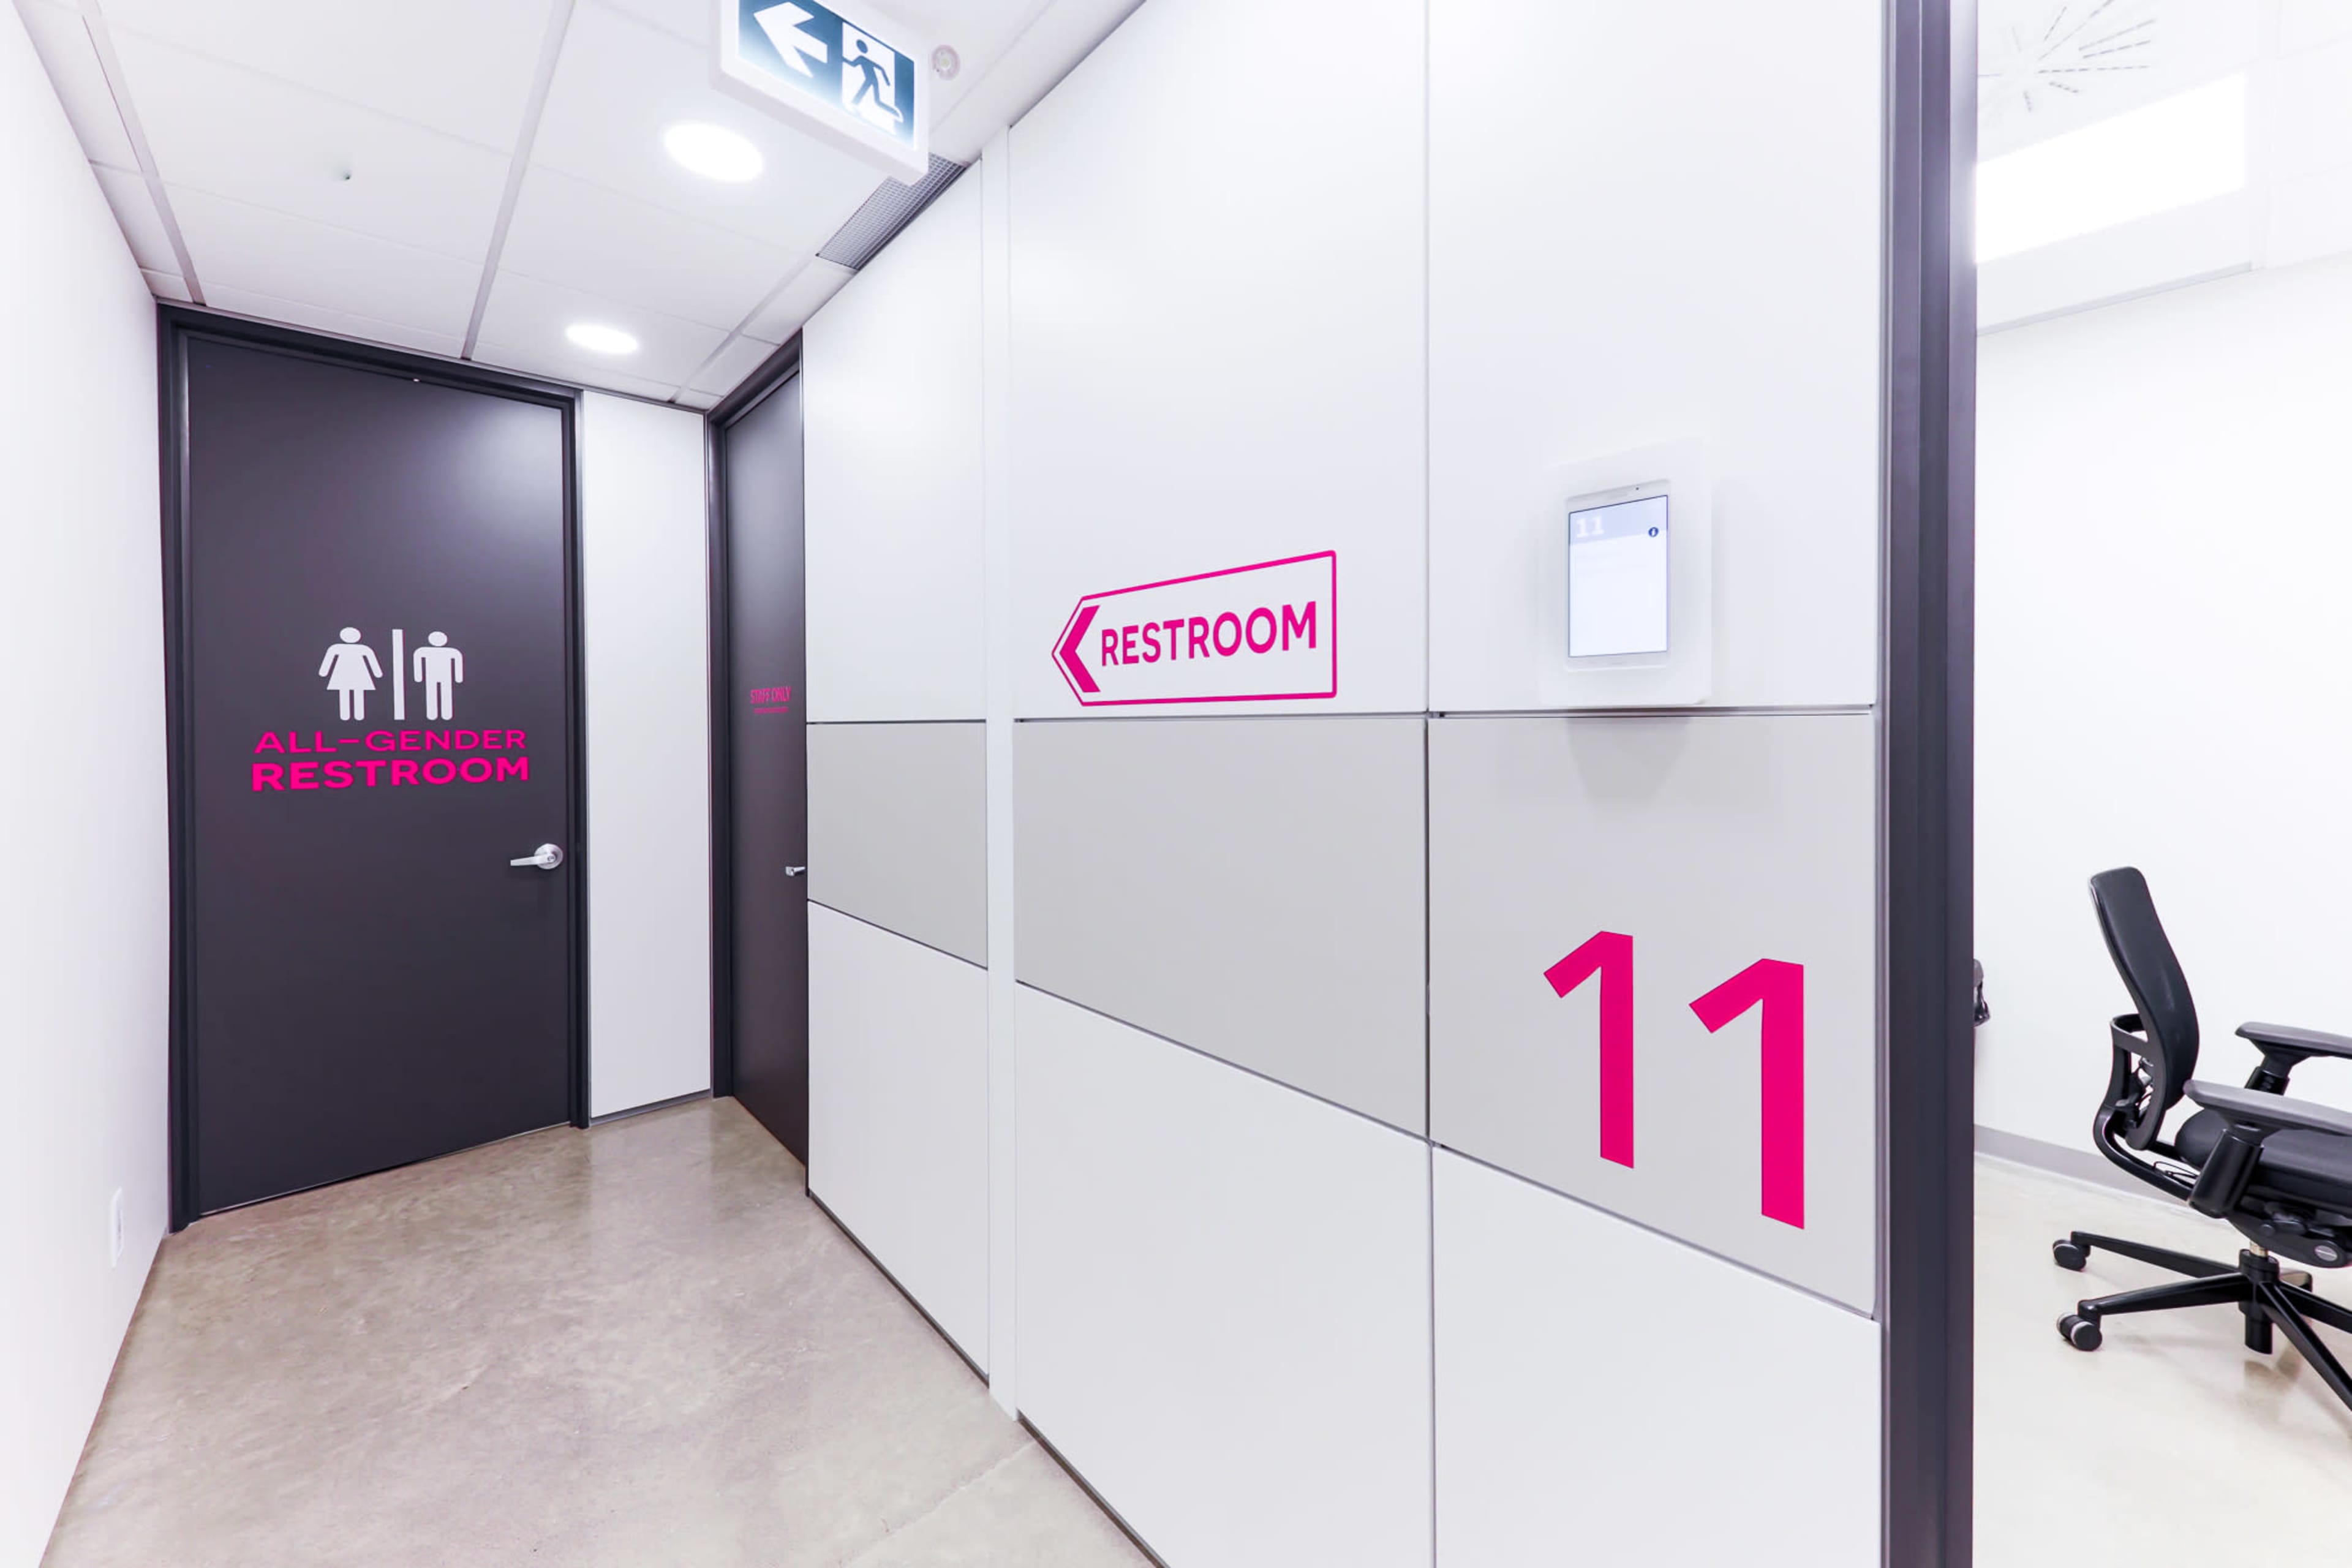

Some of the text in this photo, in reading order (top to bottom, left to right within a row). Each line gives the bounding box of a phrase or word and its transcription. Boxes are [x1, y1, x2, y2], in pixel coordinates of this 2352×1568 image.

[1576, 516, 1605, 538] 11
[1102, 601, 1316, 666] RESTROOM
[750, 687, 791, 704] STAFF ONLY
[253, 729, 526, 754] ALL-GENDER
[252, 756, 529, 791] RESTROOM
[1544, 930, 1804, 1229] 11
